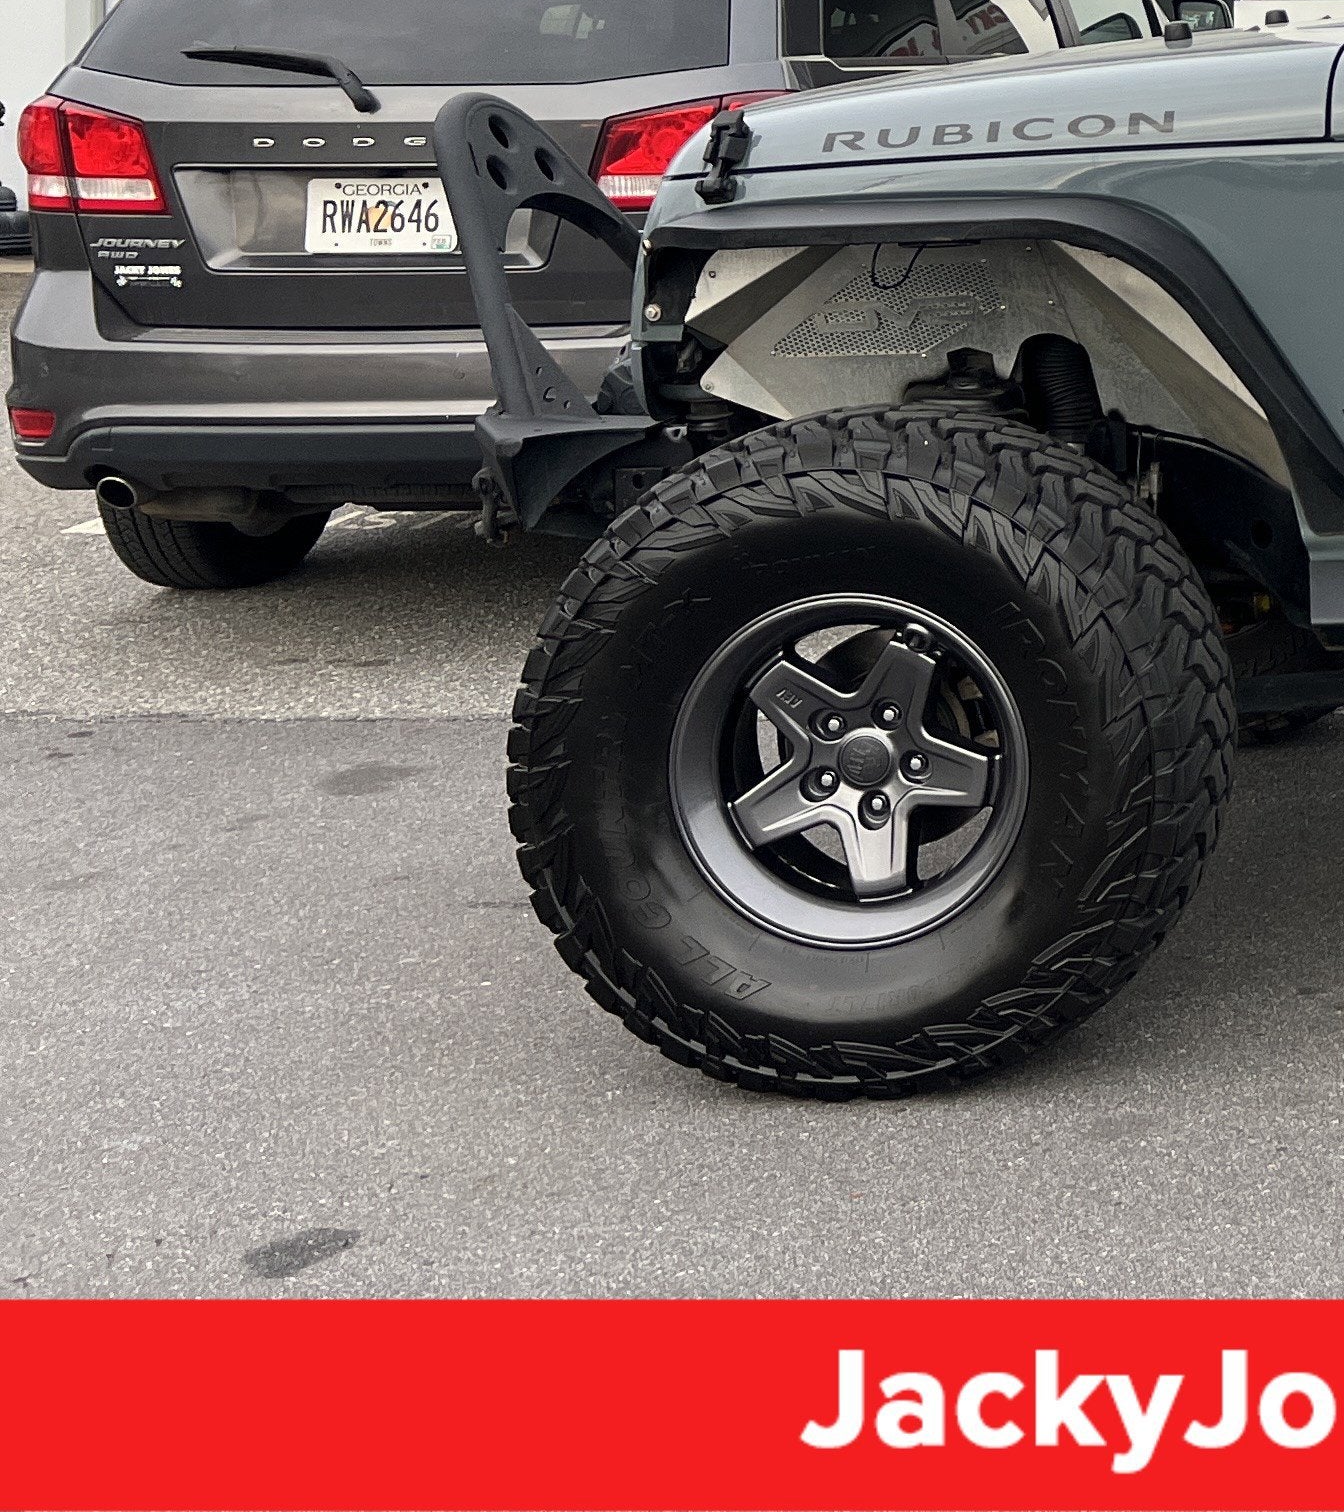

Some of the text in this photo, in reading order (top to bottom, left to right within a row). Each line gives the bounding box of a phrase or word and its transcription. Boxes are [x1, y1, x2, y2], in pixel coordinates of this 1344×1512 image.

[821, 110, 1176, 153] RUBICON
[252, 136, 428, 148] DODG
[342, 183, 423, 196] GEORGIA
[321, 198, 440, 234] RWA2646
[89, 238, 187, 249] JOURNEY
[97, 250, 139, 259] AWD
